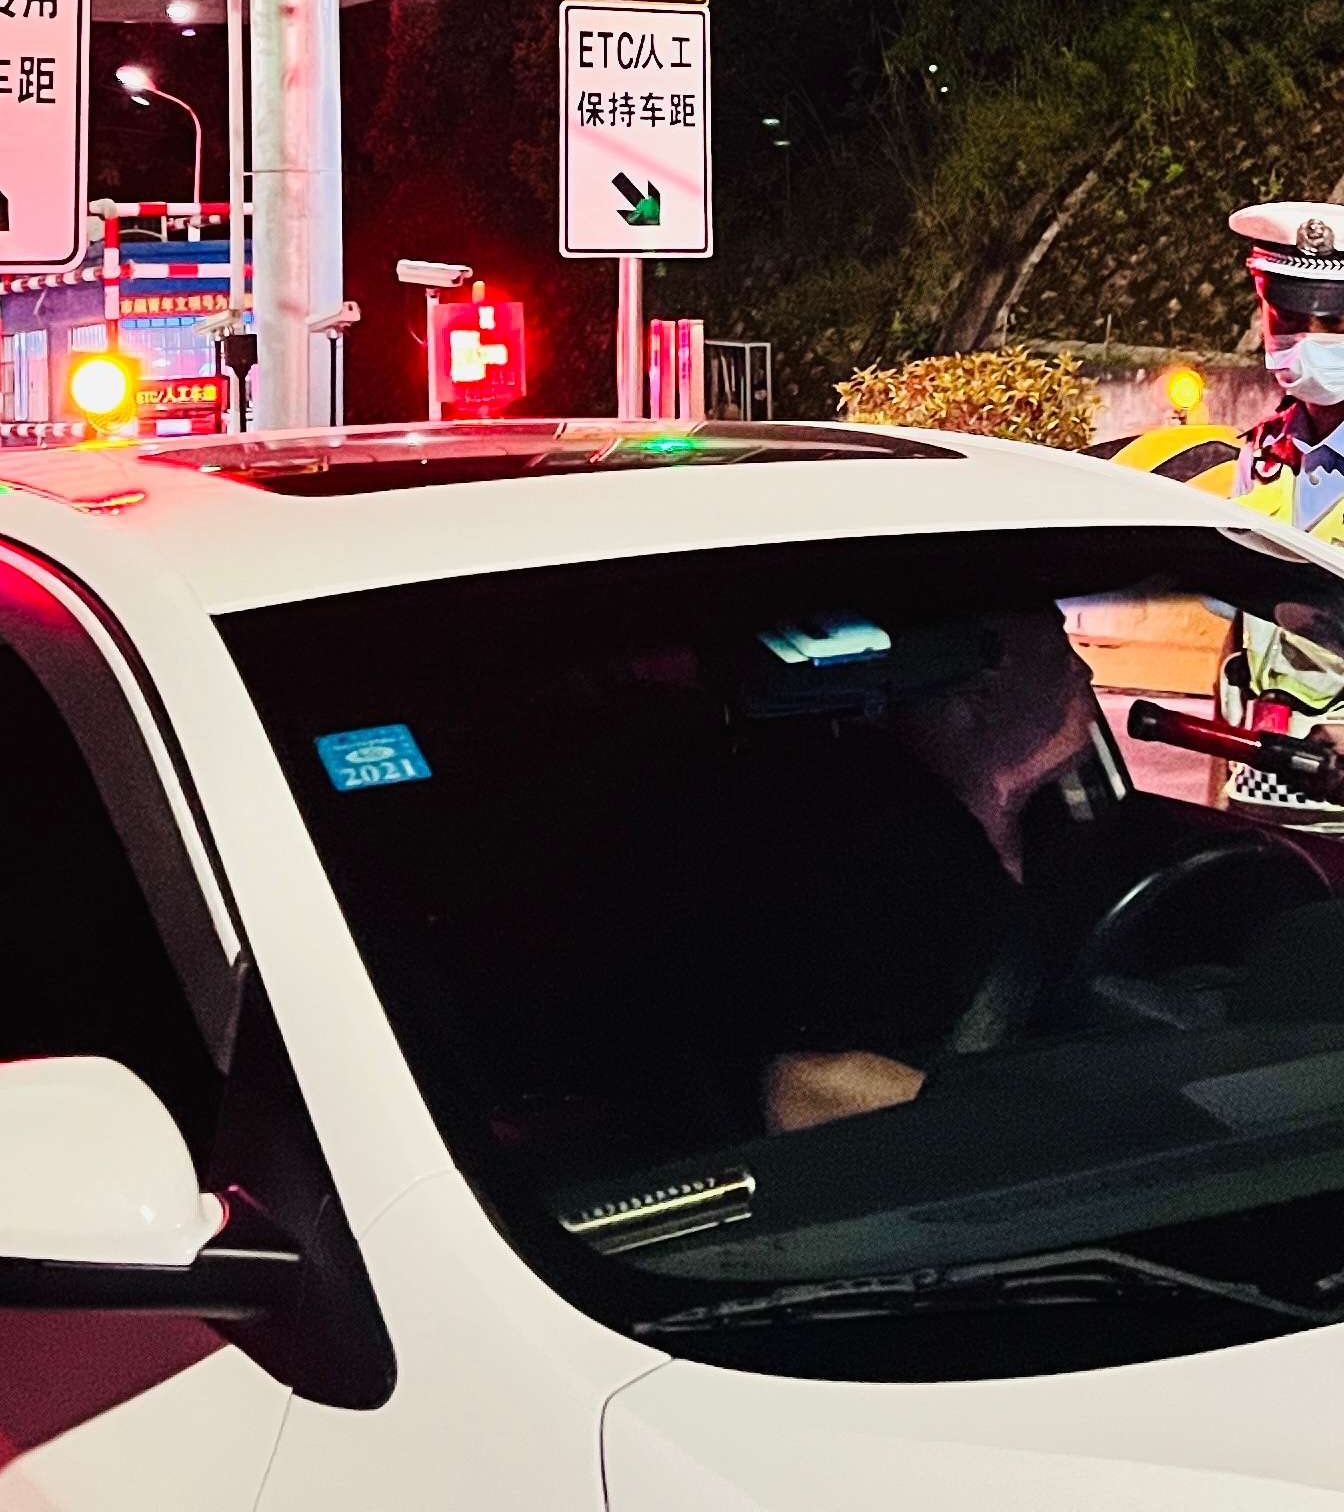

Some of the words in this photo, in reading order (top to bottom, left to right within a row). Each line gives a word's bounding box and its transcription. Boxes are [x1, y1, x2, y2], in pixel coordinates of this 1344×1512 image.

[579, 31, 692, 69] ETC/人工
[577, 91, 696, 127] 保持车距
[340, 758, 416, 787] 2021
